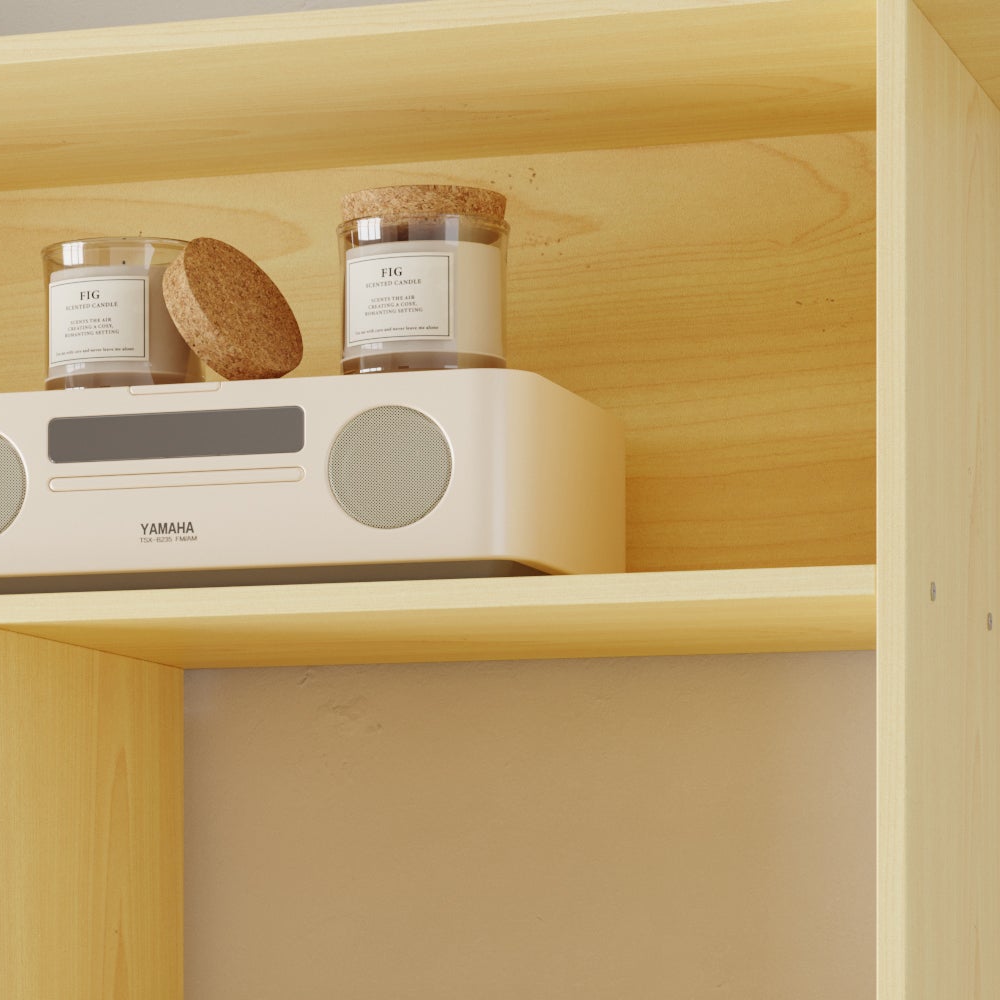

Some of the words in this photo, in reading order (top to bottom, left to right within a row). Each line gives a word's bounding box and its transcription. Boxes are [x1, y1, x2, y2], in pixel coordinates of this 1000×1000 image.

[381, 266, 402, 278] FIG
[80, 290, 100, 300] FIG
[140, 521, 194, 535] YAMAHA
